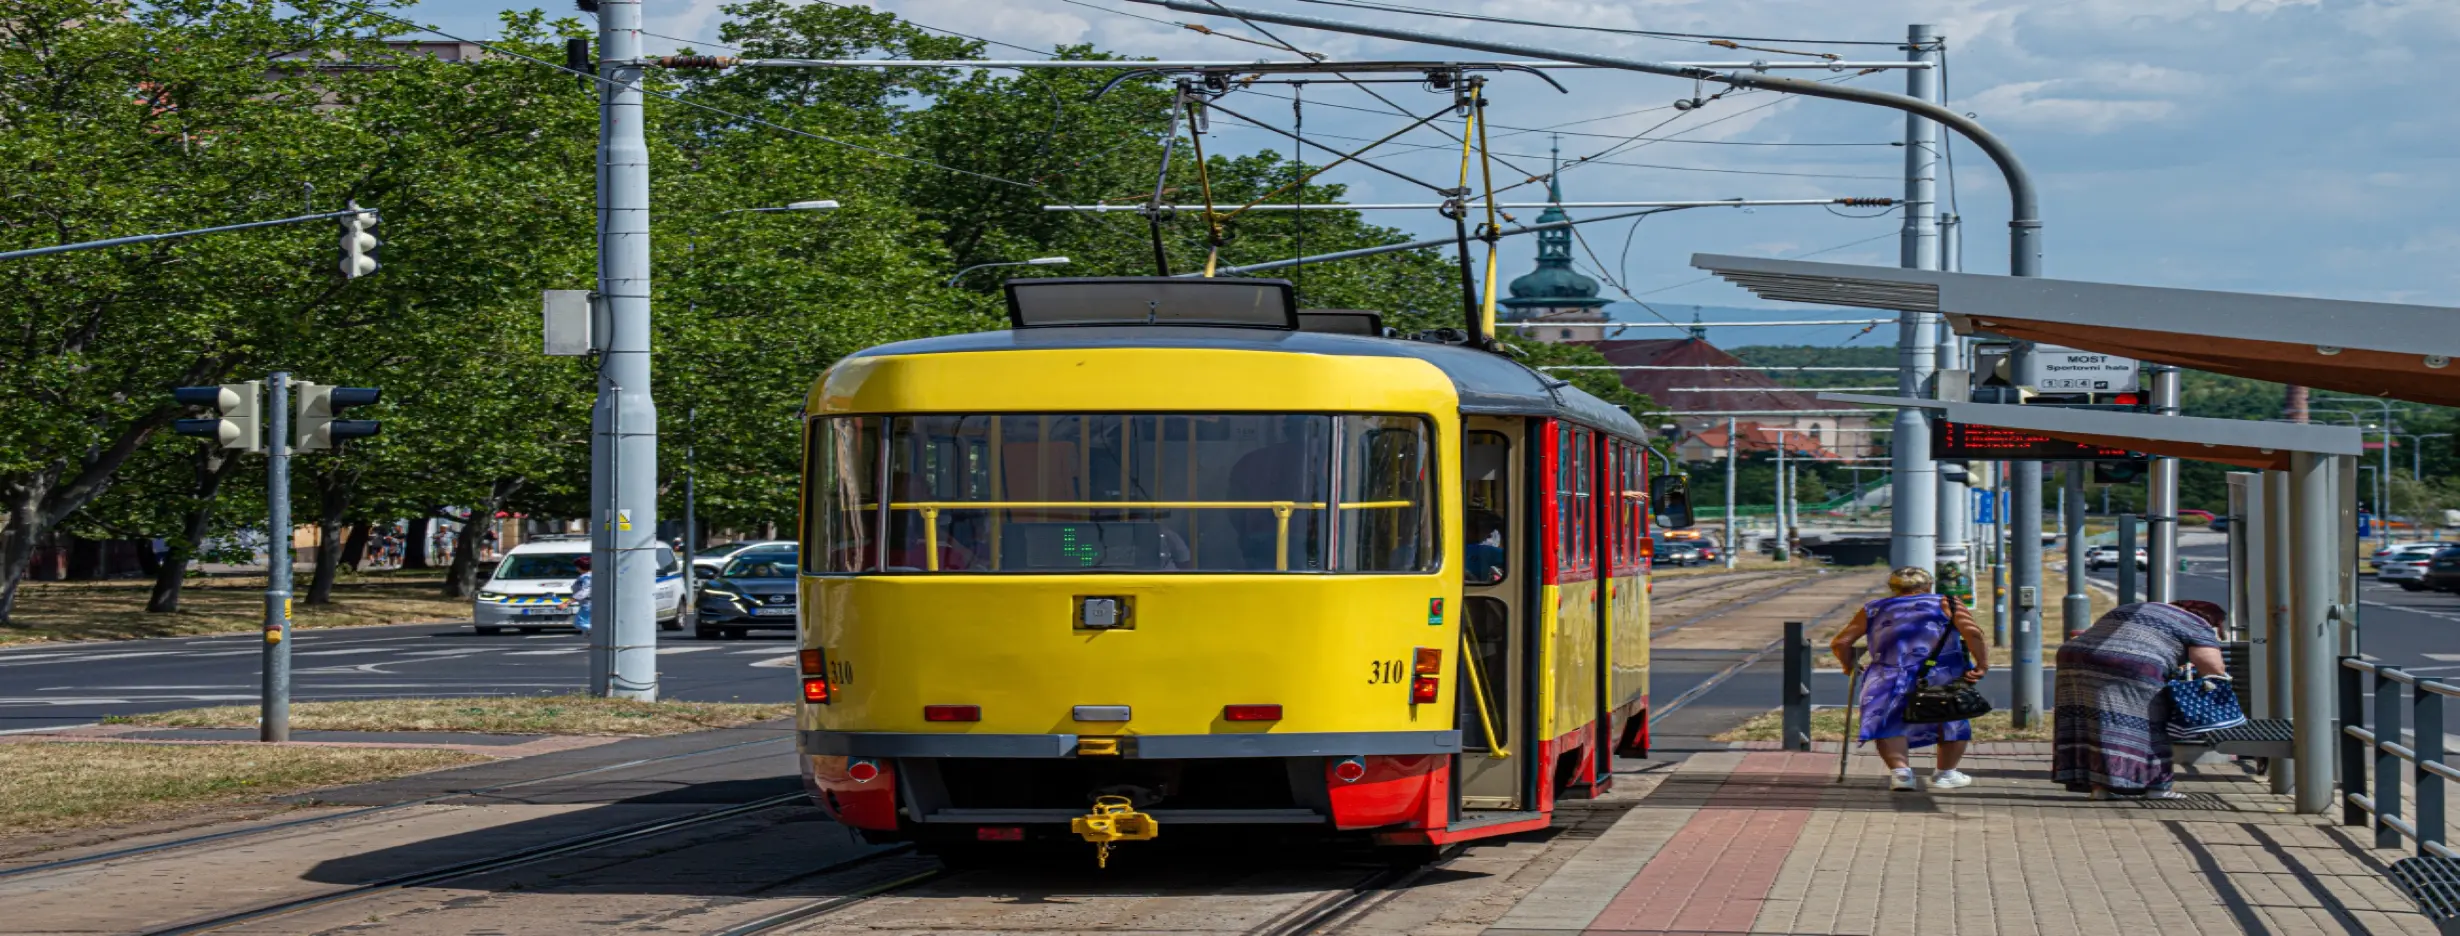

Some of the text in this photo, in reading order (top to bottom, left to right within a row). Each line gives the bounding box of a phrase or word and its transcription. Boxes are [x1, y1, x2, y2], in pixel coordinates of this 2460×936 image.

[2067, 355, 2108, 363] MOST
[830, 660, 854, 685] 310
[1367, 659, 1404, 684] 310
